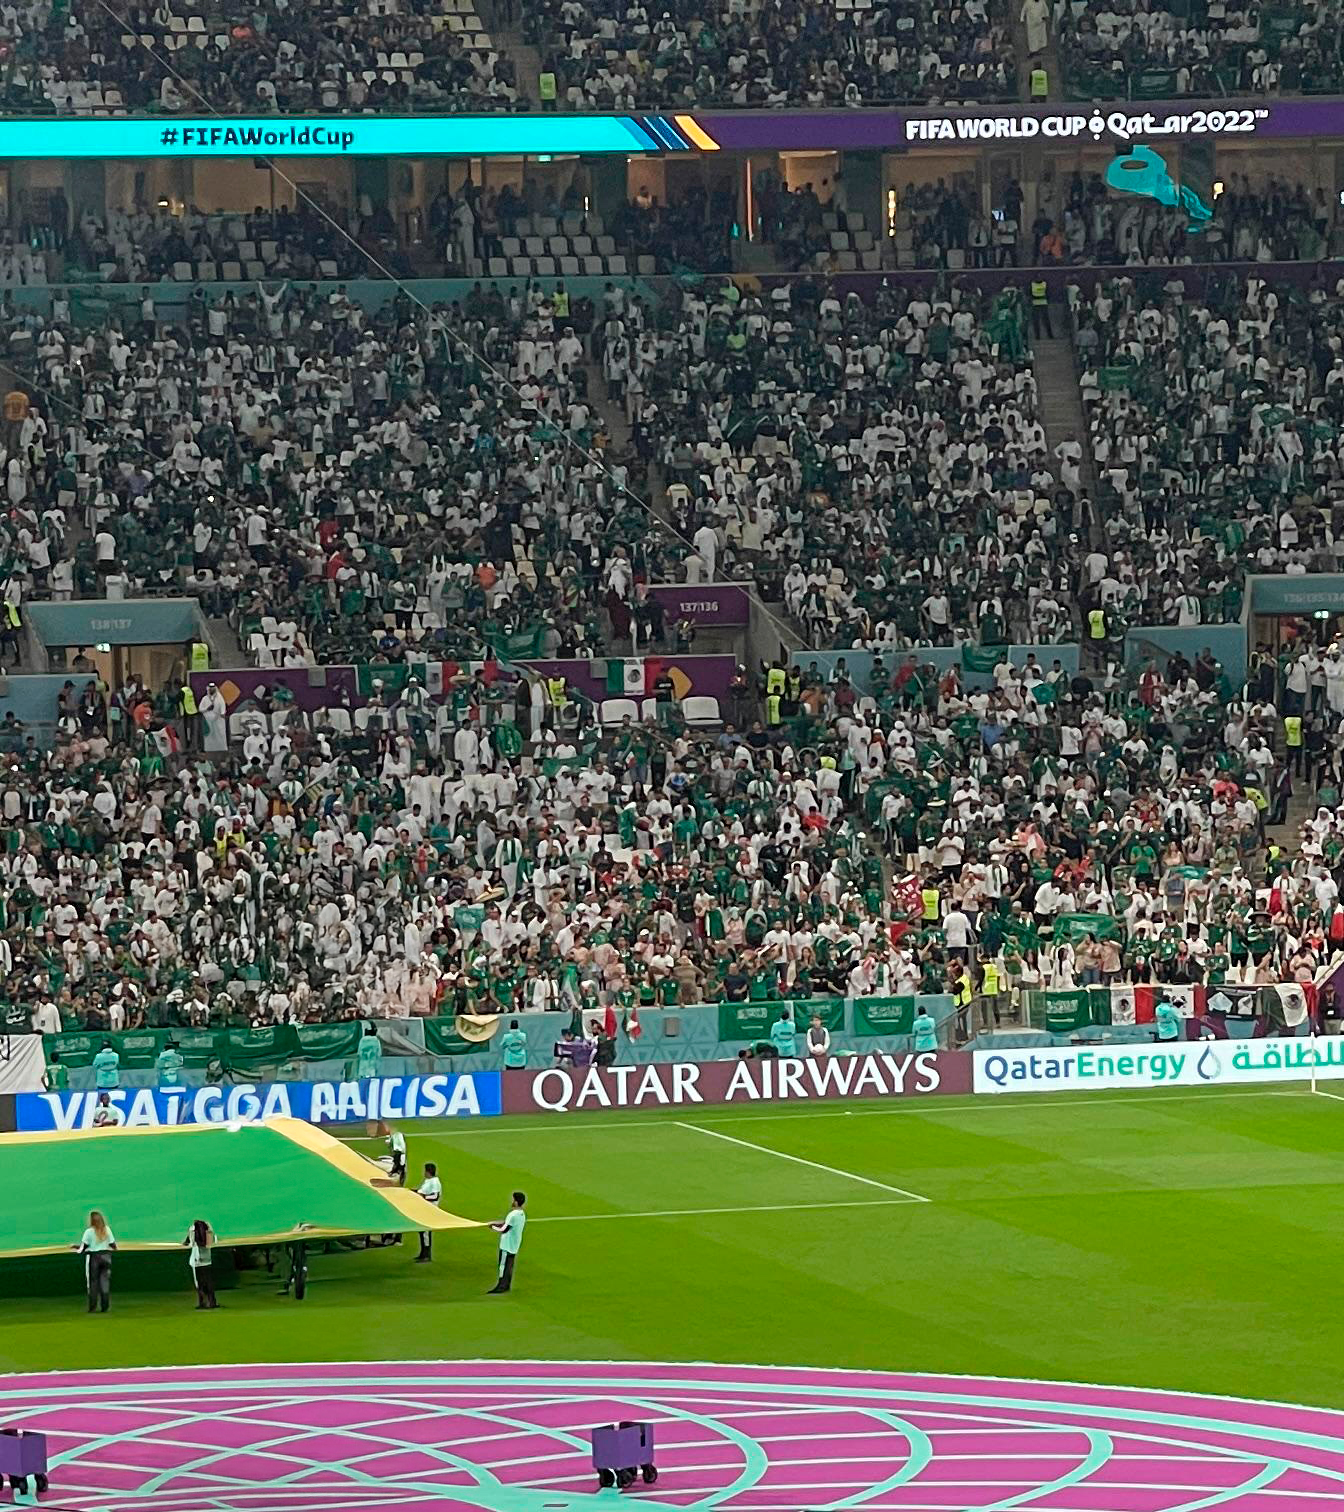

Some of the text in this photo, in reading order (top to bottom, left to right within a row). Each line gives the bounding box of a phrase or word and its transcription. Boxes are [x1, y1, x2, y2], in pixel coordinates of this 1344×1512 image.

[160, 126, 355, 151] #FIFAWorldCup
[906, 119, 955, 140] FIFA
[956, 117, 1039, 139] WORLD
[1041, 116, 1086, 137] CUP
[532, 1053, 941, 1112] QATAR AIRWAYS
[984, 1052, 1186, 1086] QatarEnergy
